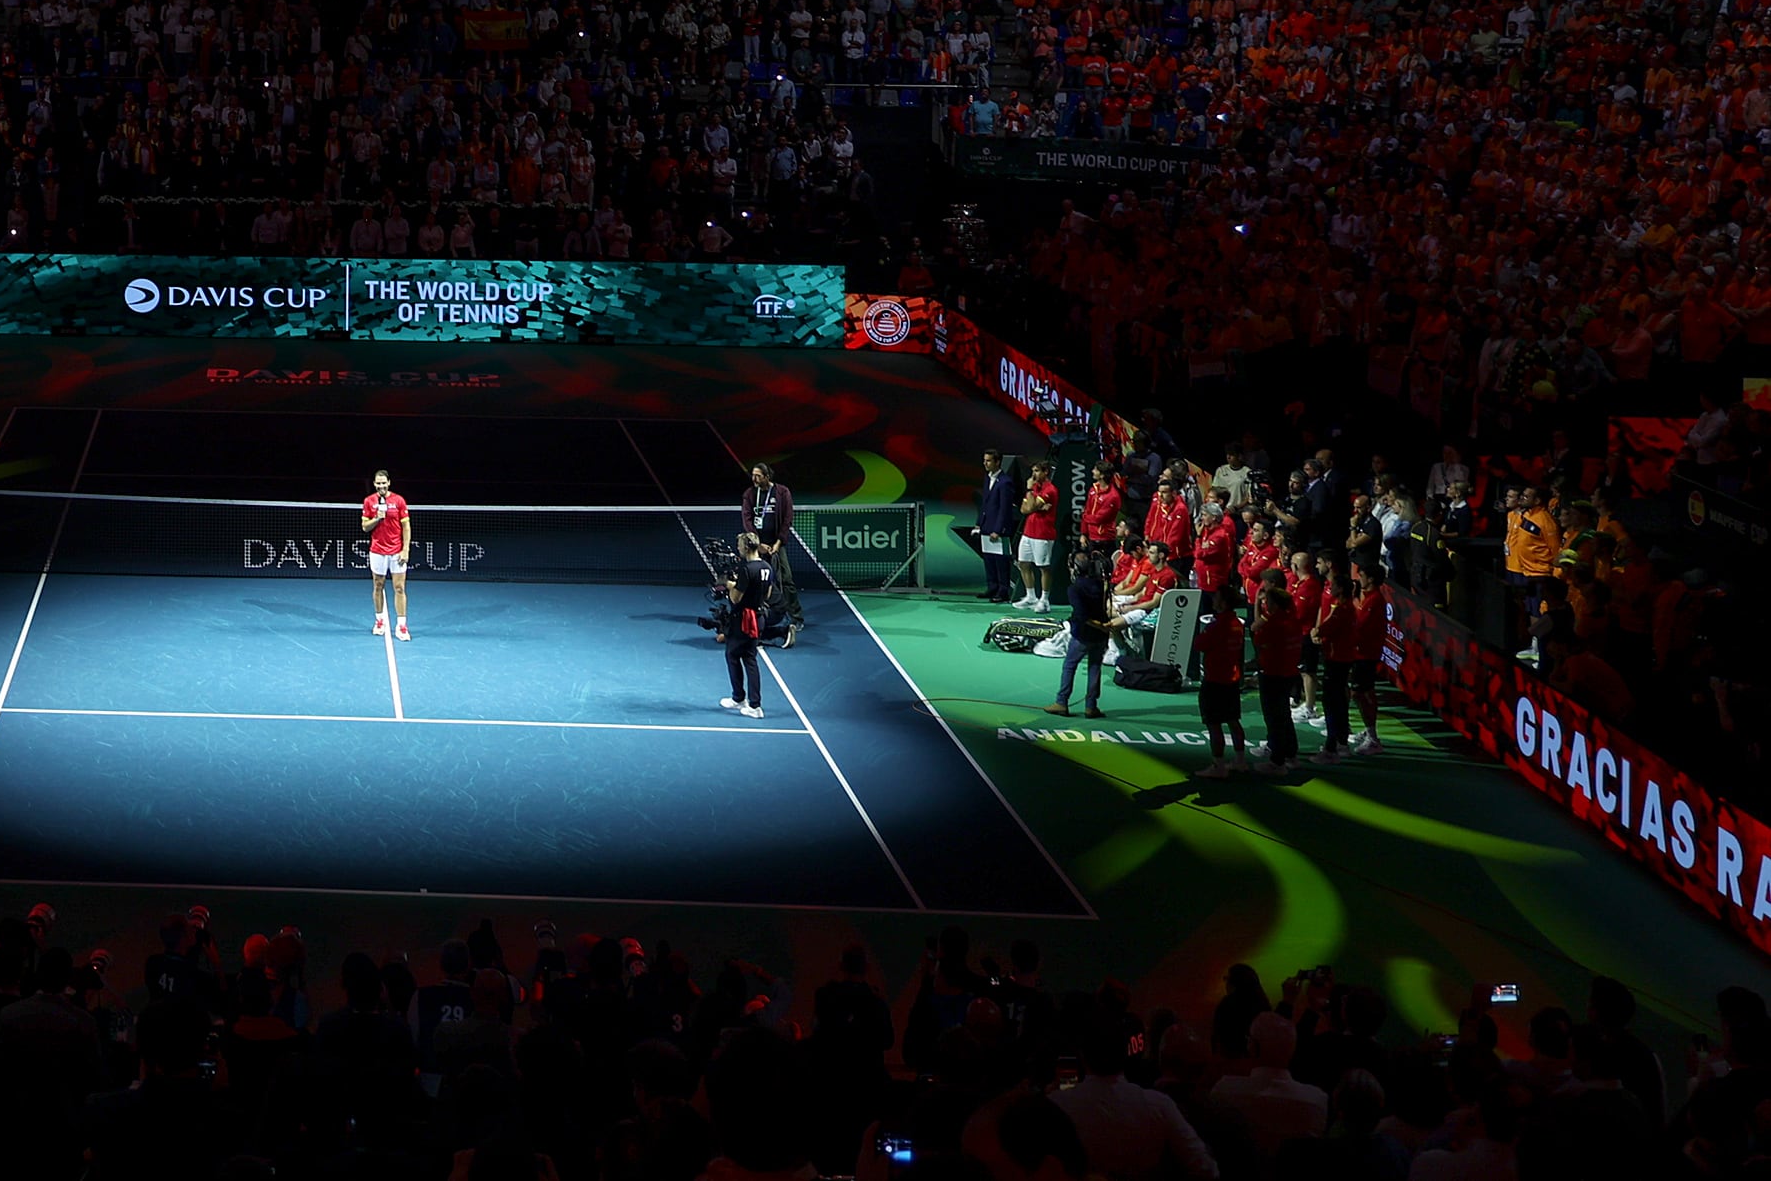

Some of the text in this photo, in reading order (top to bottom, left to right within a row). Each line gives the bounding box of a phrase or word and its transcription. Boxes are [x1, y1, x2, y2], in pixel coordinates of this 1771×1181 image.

[1036, 151, 1069, 167] THE
[1071, 153, 1128, 170] WORLD
[1130, 156, 1158, 173] CUP
[1159, 159, 1178, 174] OF
[168, 285, 326, 309] DAVIS CUP
[364, 280, 554, 301] THE WORLD CUP
[398, 302, 519, 324] OF TENNIS
[756, 301, 783, 315] ITF
[206, 367, 501, 383] DAVIS CUP
[821, 524, 900, 550] Haier
[243, 539, 370, 569] DAVIS
[1171, 609, 1185, 642] DAVIS
[1515, 696, 1696, 869] GRACIAS
